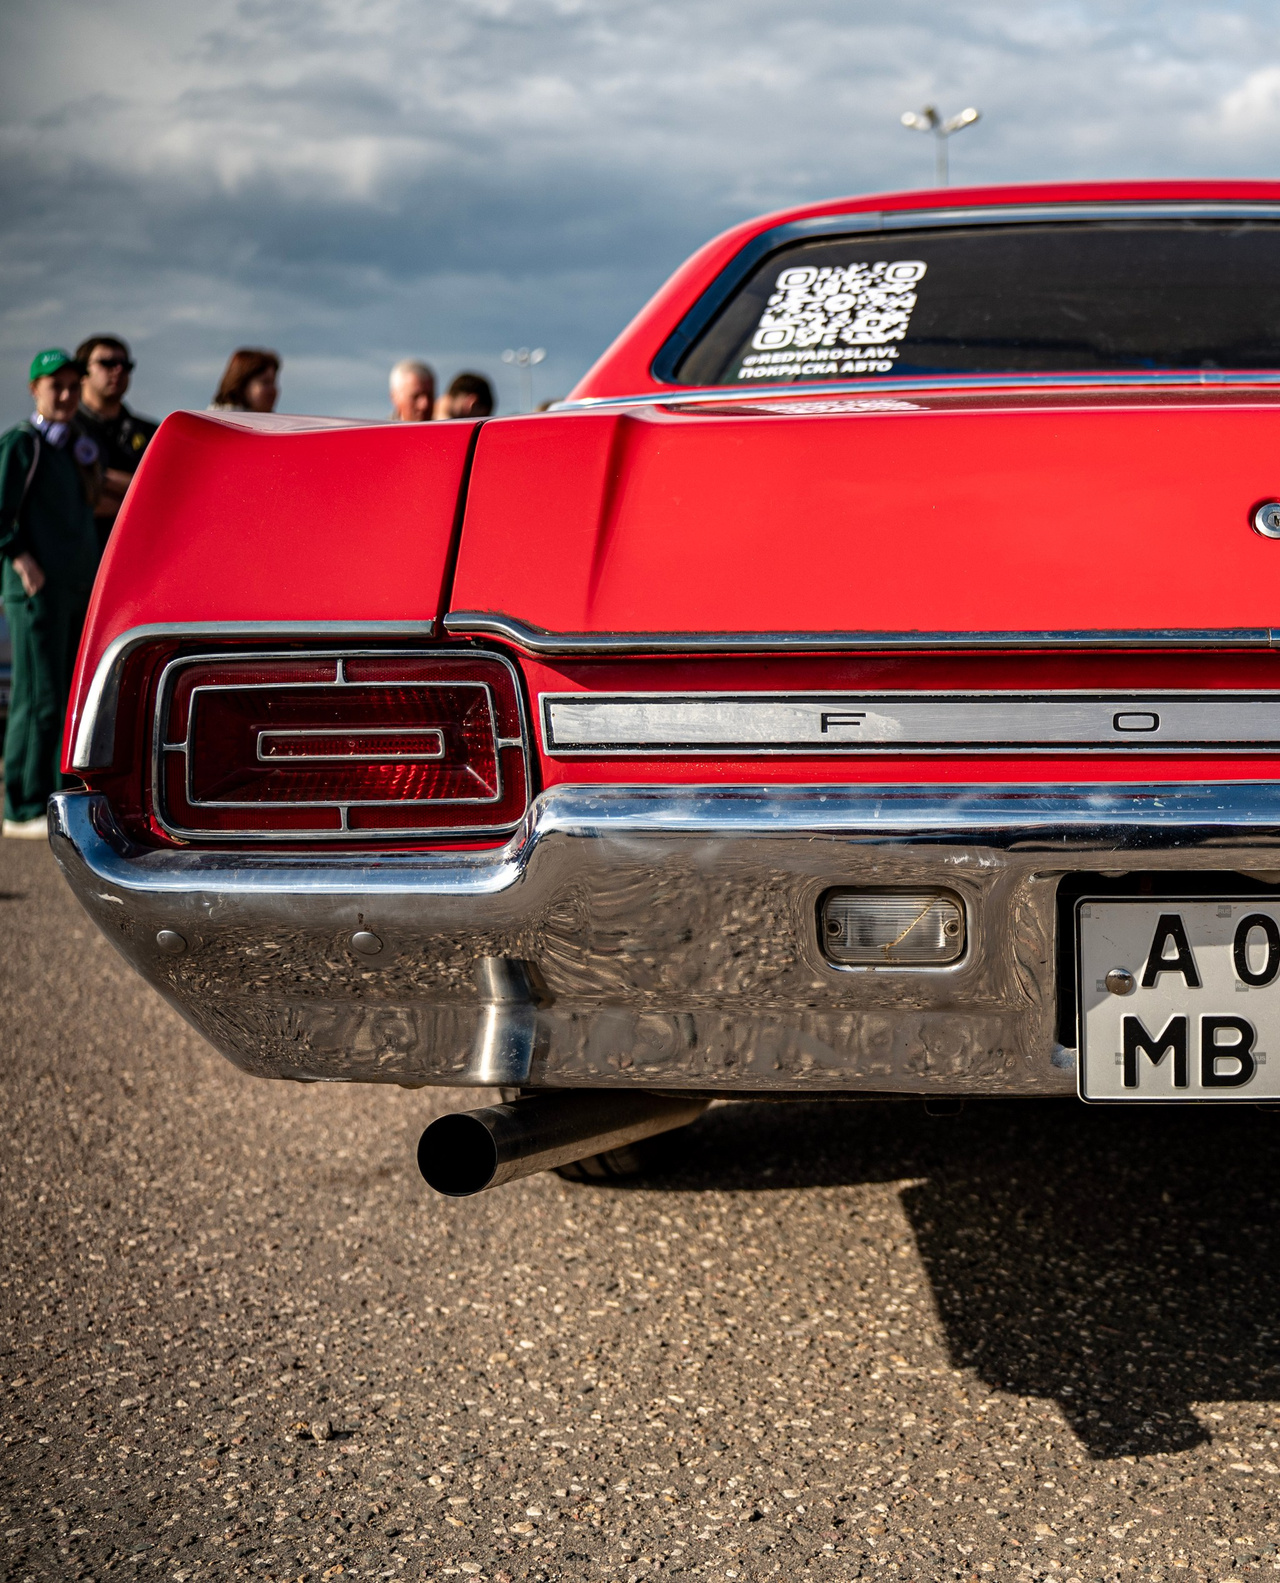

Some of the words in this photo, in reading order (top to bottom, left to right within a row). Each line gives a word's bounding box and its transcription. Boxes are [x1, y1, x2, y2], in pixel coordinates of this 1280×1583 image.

[744, 347, 899, 366] @REDYAROSLAVL
[738, 362, 838, 379] ПОКРАСКА
[841, 360, 893, 373] АВТО
